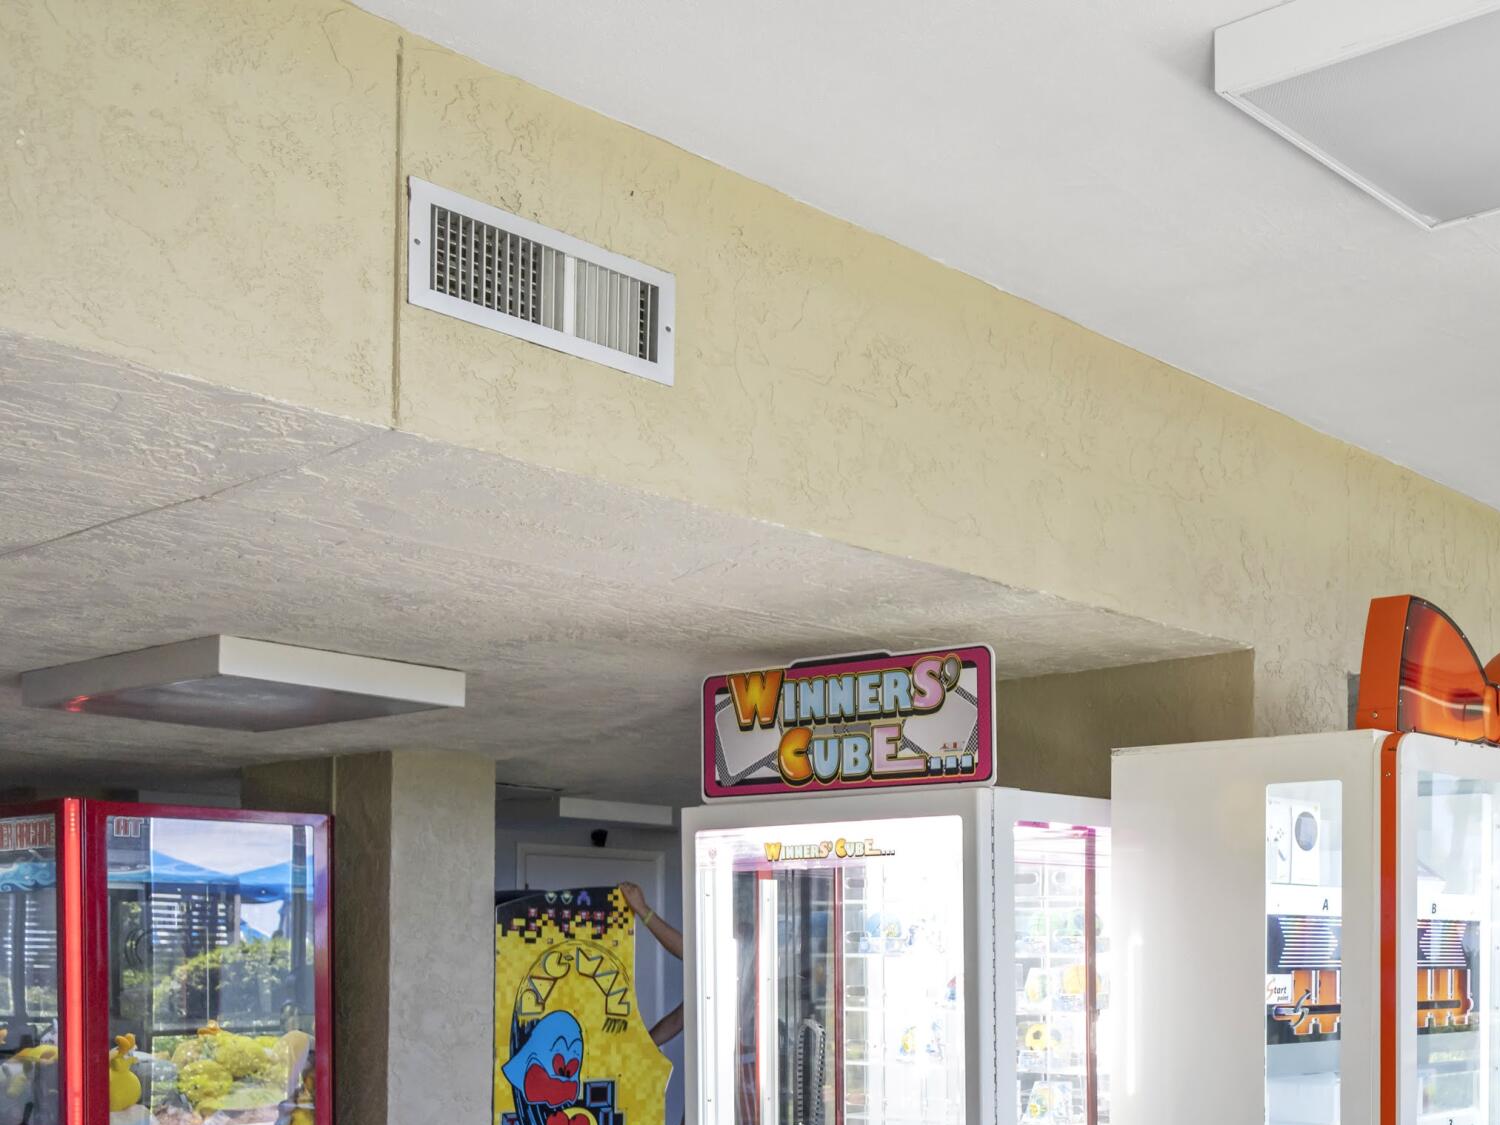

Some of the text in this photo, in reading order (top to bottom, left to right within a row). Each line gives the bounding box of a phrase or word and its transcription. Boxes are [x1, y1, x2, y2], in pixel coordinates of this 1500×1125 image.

[728, 654, 961, 731] WINNERS'
[1322, 898, 1329, 910] A
[1431, 903, 1437, 914] B
[517, 946, 631, 1016] PAC-MAN
